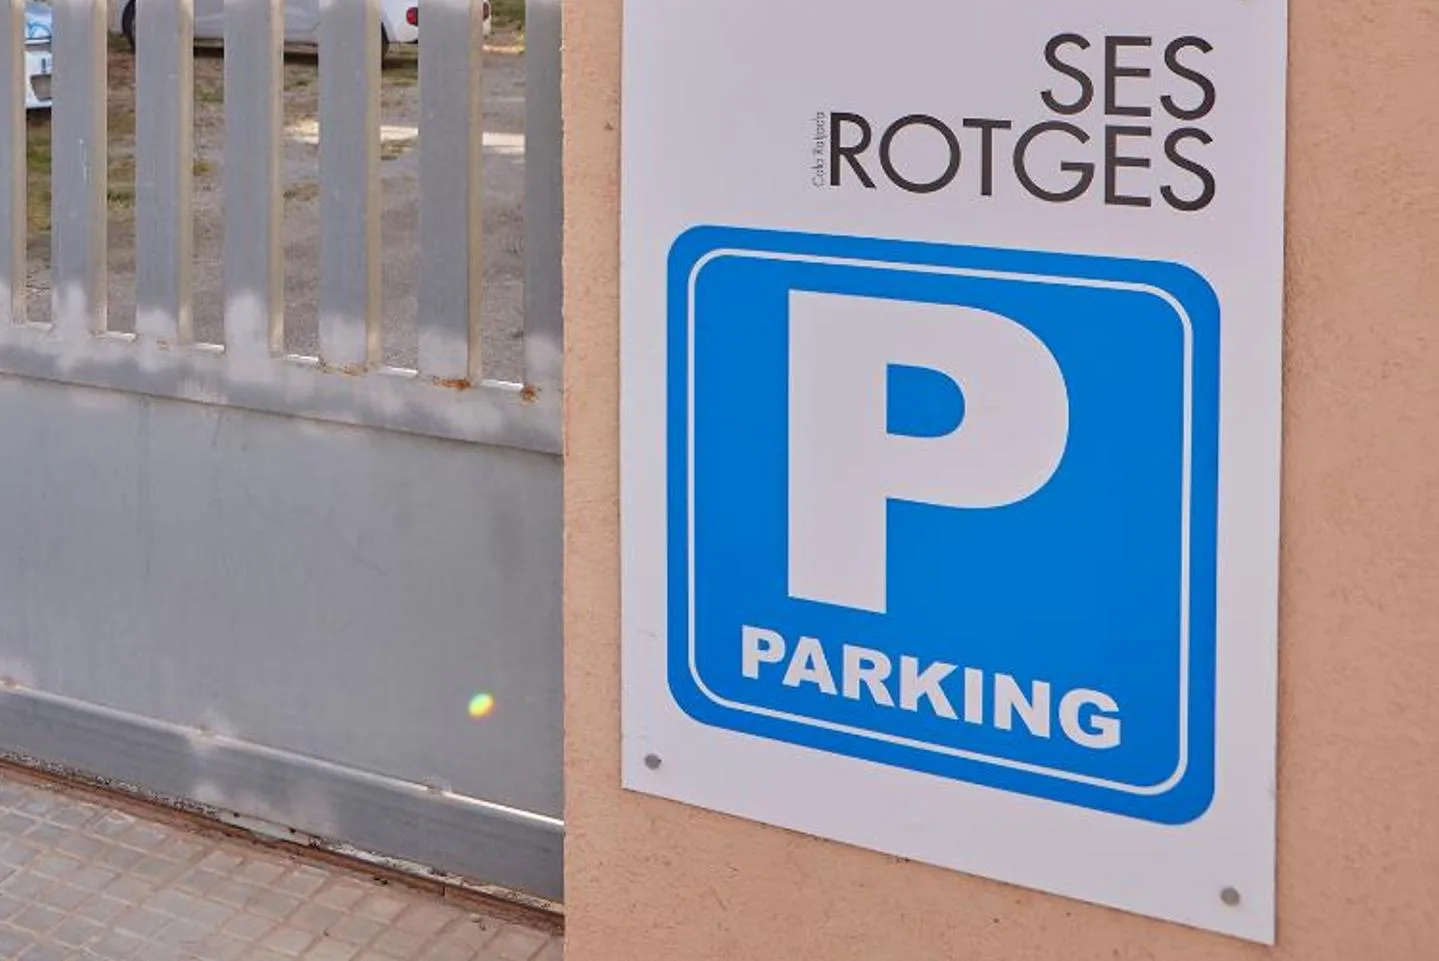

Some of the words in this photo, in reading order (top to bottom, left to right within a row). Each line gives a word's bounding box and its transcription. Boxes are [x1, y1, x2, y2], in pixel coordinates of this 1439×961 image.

[1039, 32, 1217, 121] SES
[827, 111, 1217, 212] ROTGES
[788, 288, 1069, 614] P
[741, 624, 1121, 749] PARKING
